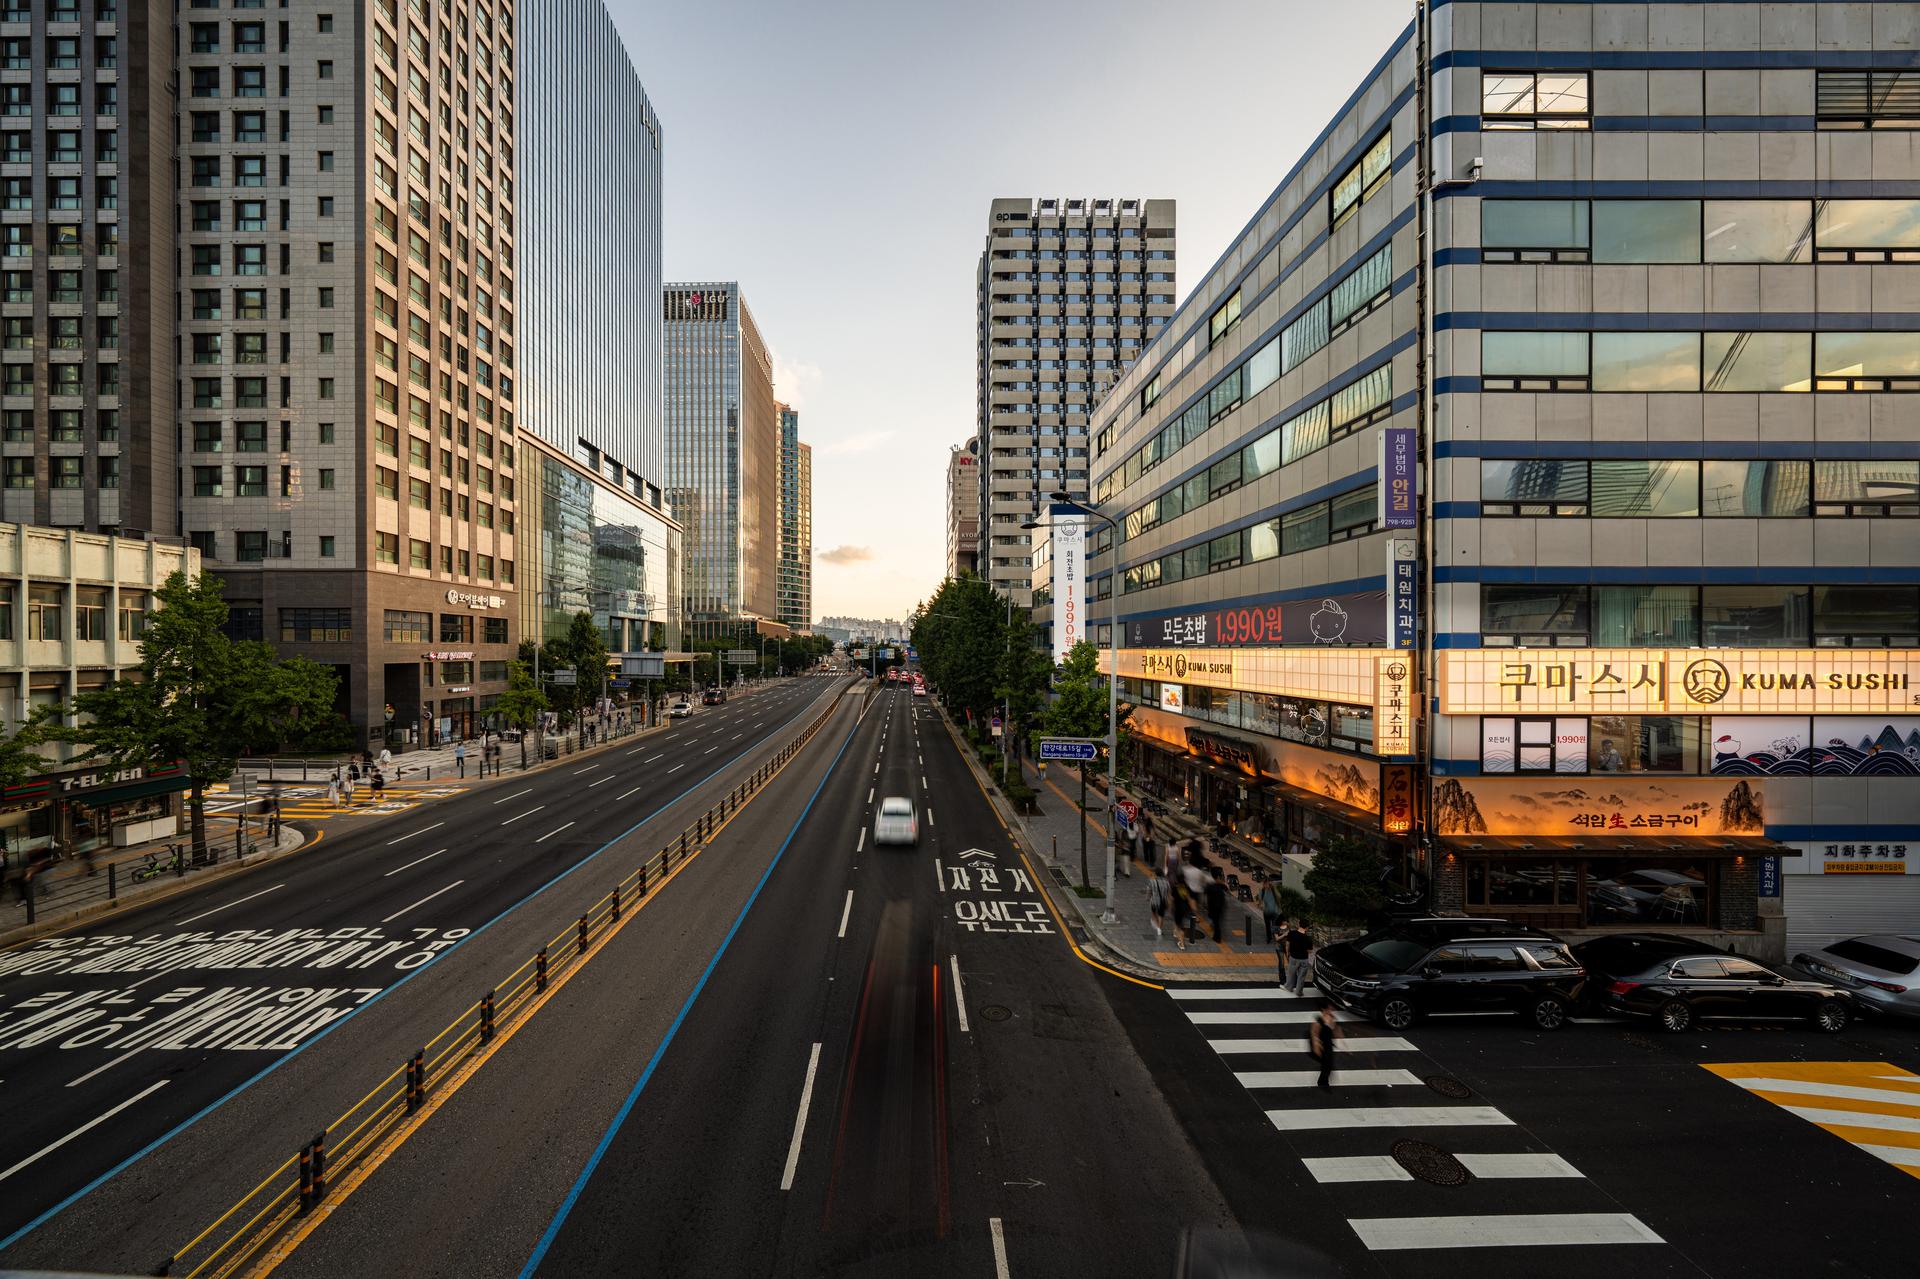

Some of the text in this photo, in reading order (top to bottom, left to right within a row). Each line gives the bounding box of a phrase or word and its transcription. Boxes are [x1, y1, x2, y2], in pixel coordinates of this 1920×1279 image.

[1395, 433, 1406, 476] 세무법인
[1398, 564, 1414, 629] 태원치과
[1162, 606, 1283, 644] 모든초밥 1,990원
[1140, 653, 1233, 677] 쿠마스시 KUMA SUSHI
[1500, 661, 1909, 702] 쿠마스시 KUMA SUSHI
[1389, 684, 1404, 739] 쿠마스시
[1556, 735, 1586, 744] 1,990원
[60, 767, 142, 791] 7-ELVEn
[1824, 844, 1907, 858] 지하주차장
[947, 866, 1035, 893] 자전거
[955, 900, 1057, 934] 우선도로
